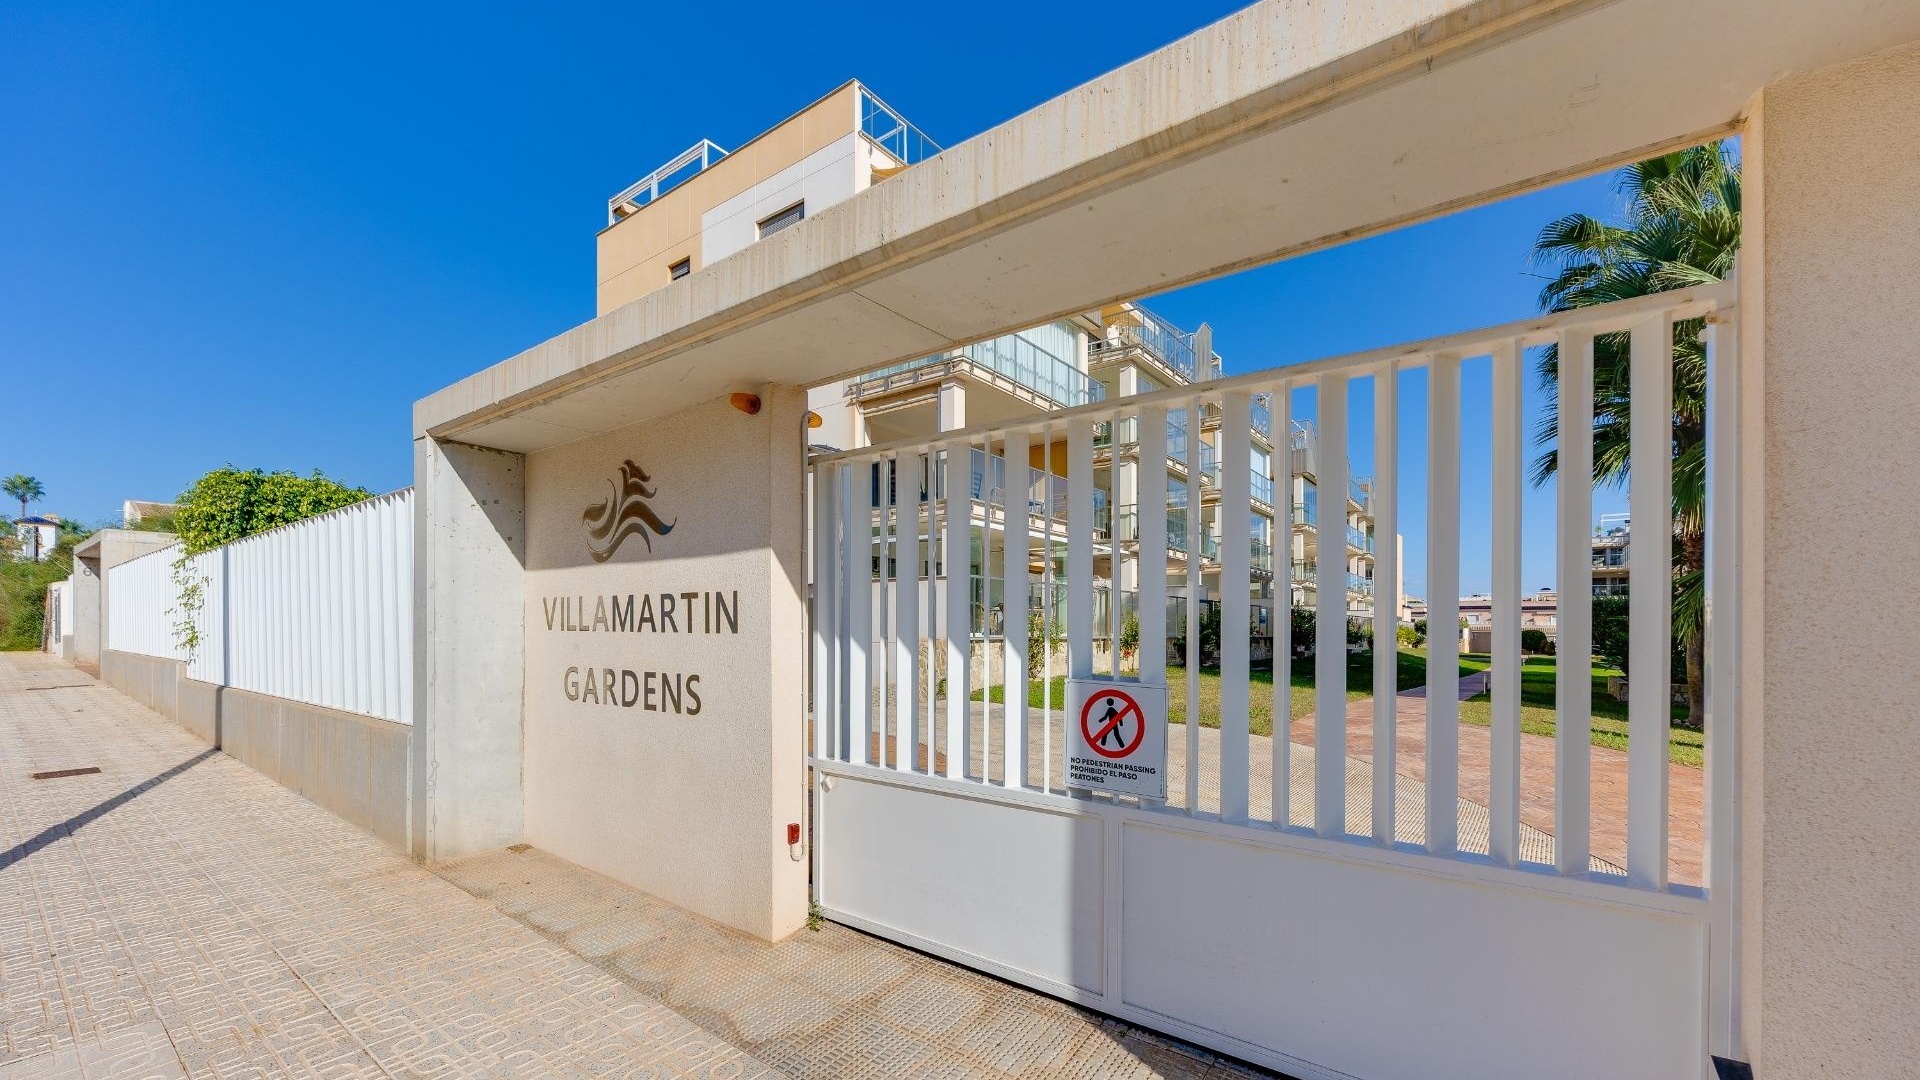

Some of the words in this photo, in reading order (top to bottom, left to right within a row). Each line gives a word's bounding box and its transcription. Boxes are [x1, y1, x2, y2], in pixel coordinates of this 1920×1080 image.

[543, 591, 739, 634] VILLAMARTIN
[564, 666, 702, 716] GARDENS
[1070, 765, 1108, 776] PROHIBIDO
[1109, 770, 1117, 778] EL
[1118, 772, 1138, 780] PASO
[1081, 758, 1123, 770] PEDESTRIAN
[1124, 764, 1156, 774] PASSING
[1070, 772, 1104, 783] PEATONES
